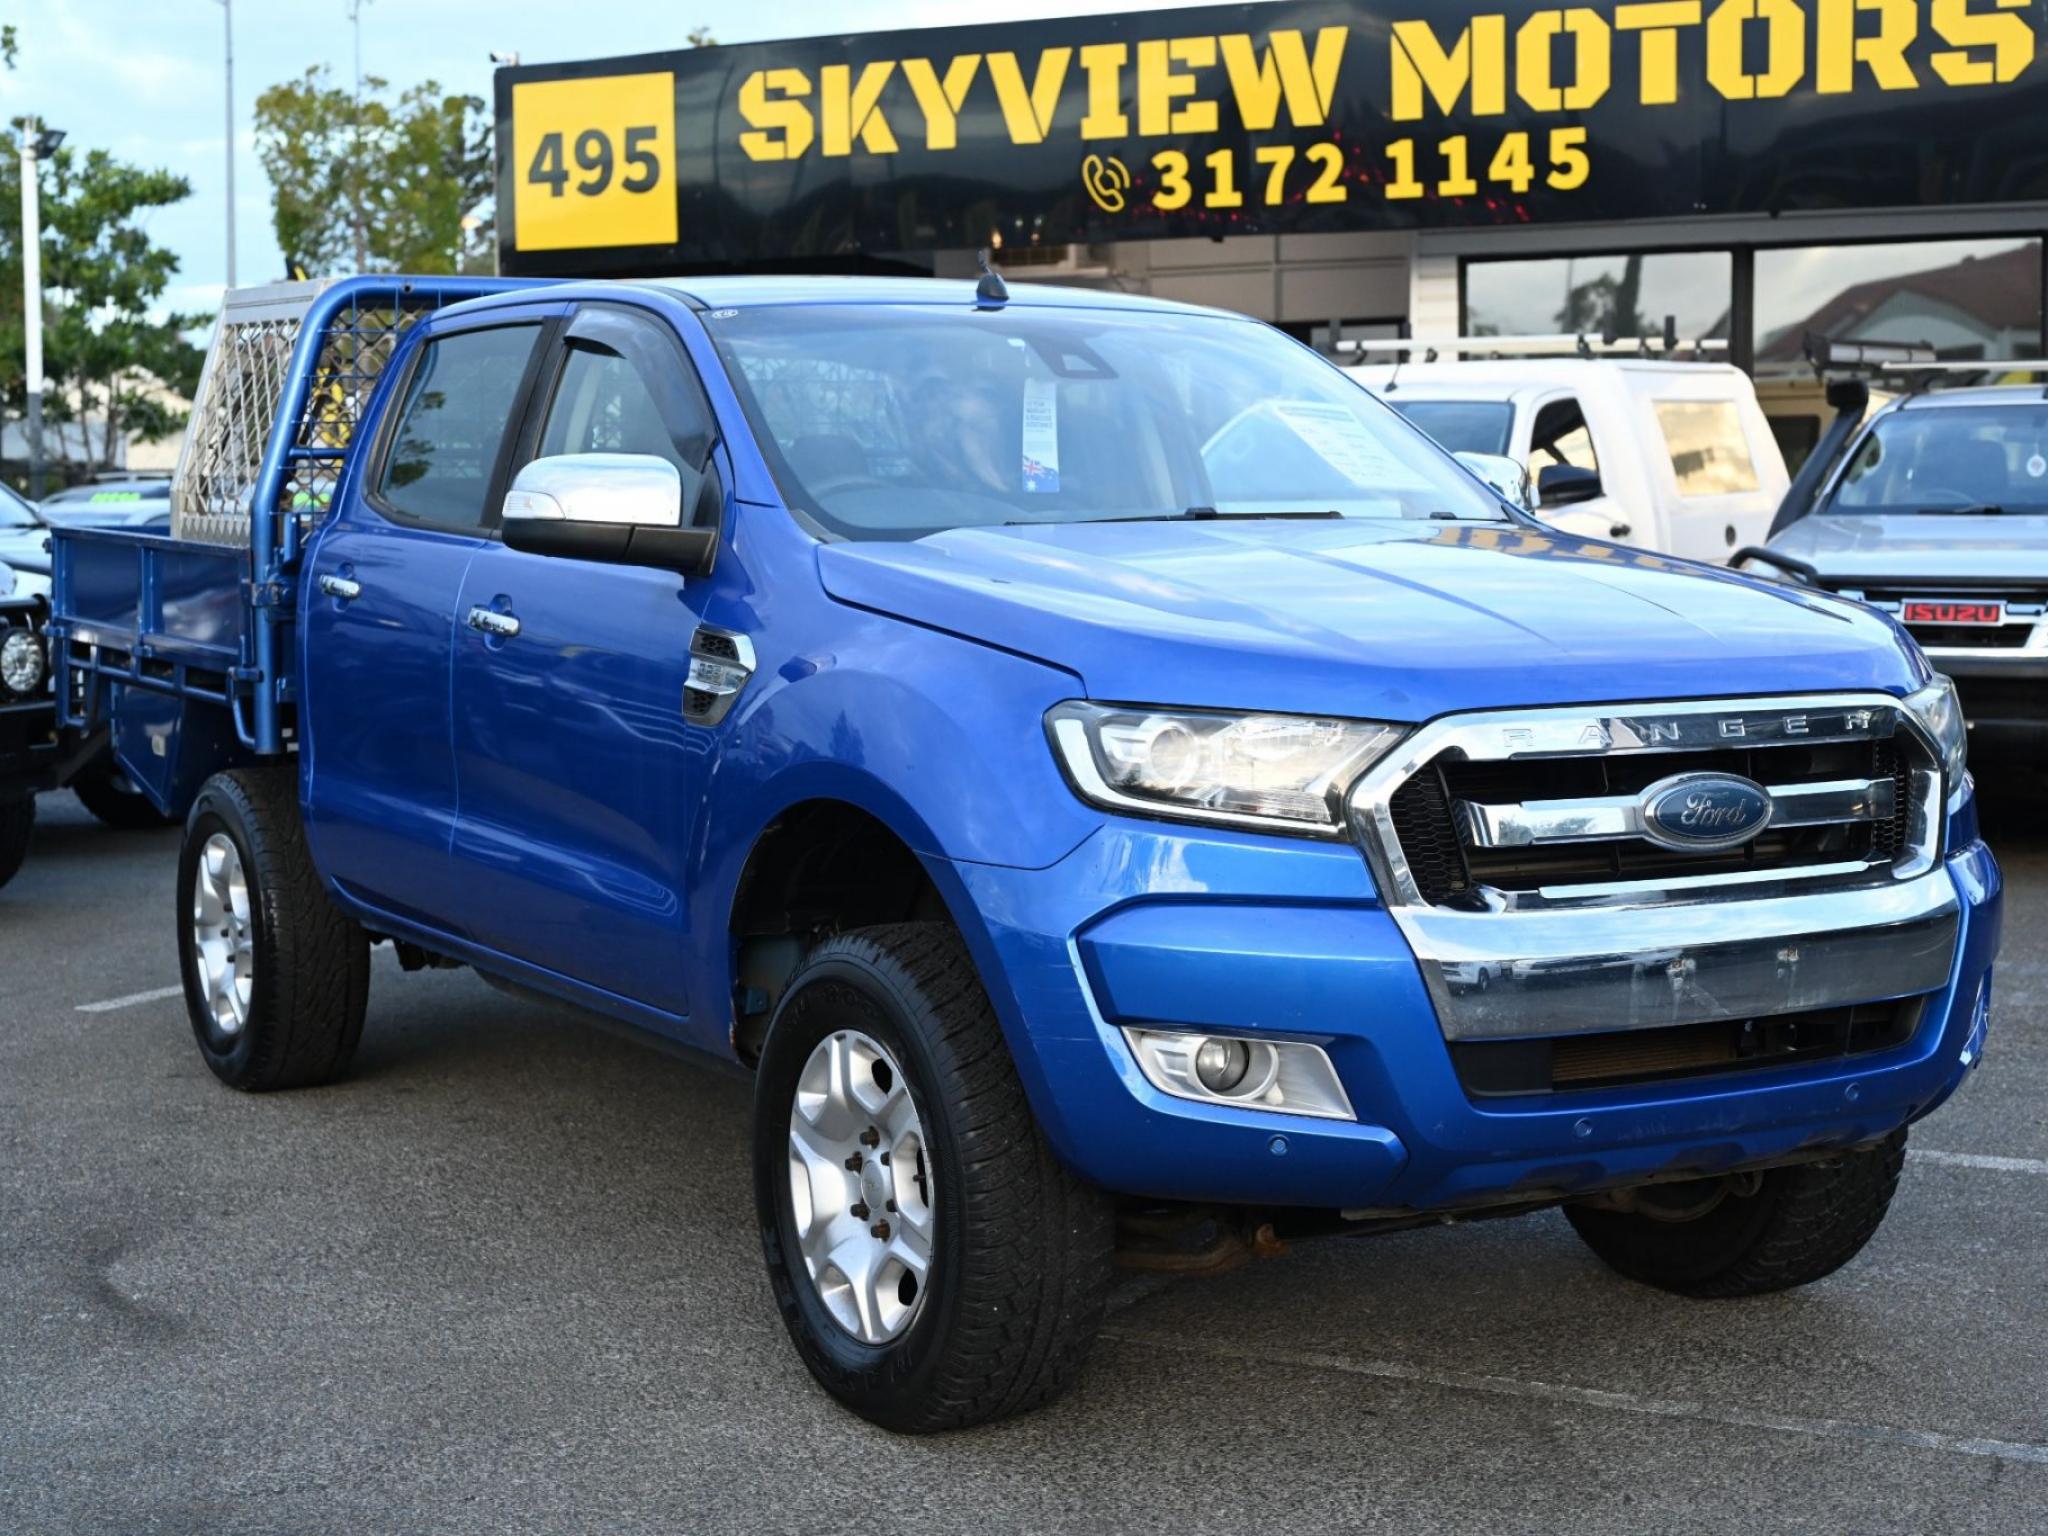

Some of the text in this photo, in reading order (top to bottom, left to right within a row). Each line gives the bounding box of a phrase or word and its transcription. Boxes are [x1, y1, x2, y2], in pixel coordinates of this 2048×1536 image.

[738, 0, 2035, 162] SKYVIEW MOTORS
[527, 126, 661, 198] 495
[1151, 126, 1591, 211] 3172 1145
[1906, 603, 1999, 622] ISUZU
[1503, 710, 1871, 749] RANGER
[1680, 790, 1747, 828] Ford
